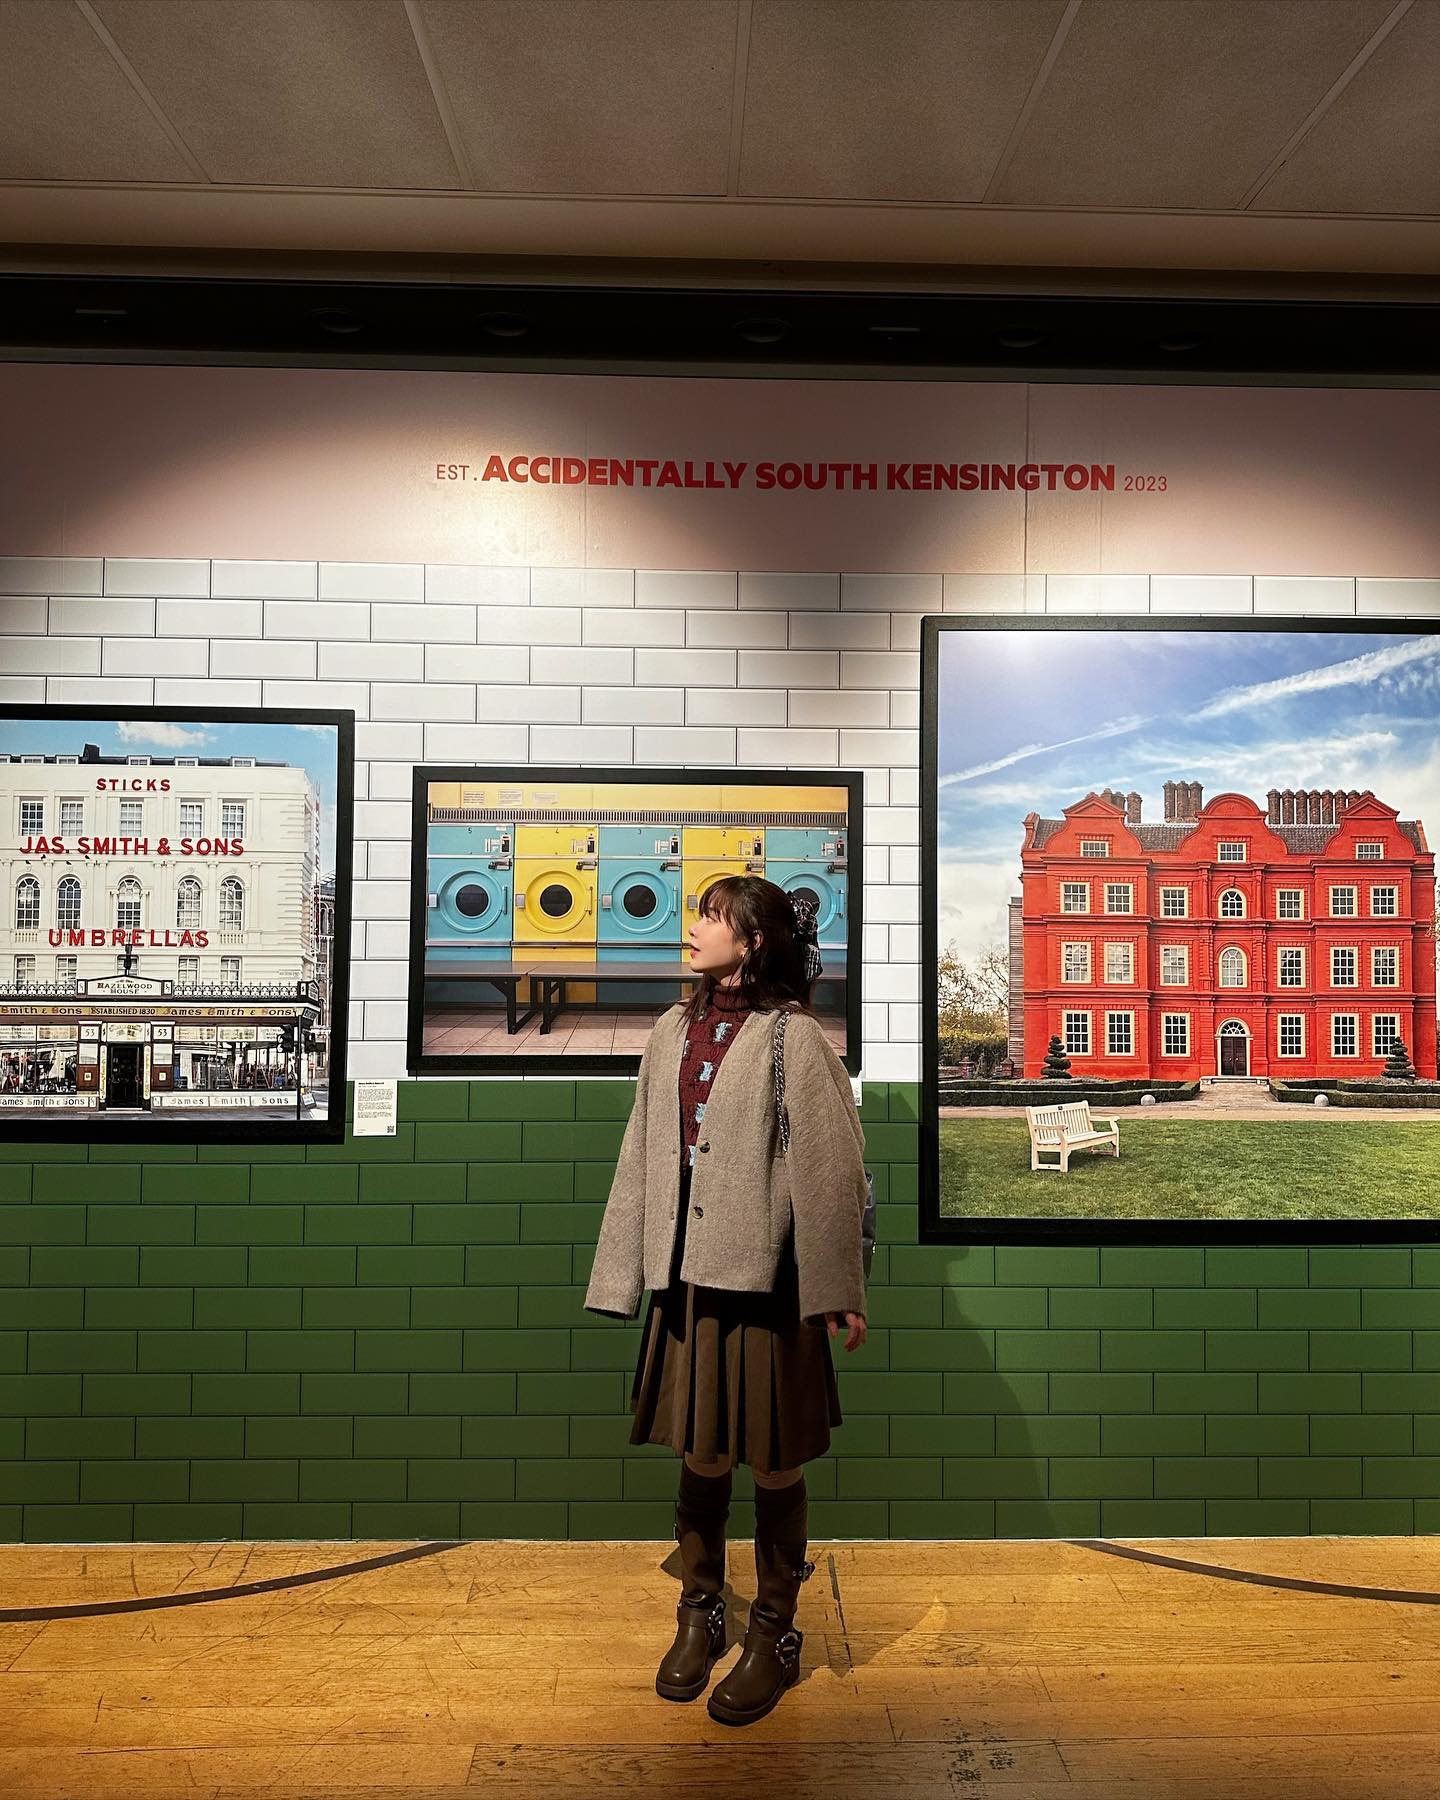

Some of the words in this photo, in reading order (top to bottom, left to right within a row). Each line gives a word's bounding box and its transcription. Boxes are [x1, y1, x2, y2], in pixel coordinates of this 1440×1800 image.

[436, 463, 478, 482] EST.
[481, 455, 748, 489] ACCIDENTALLY
[755, 462, 878, 491] SOUTH
[886, 463, 1116, 491] KENSINGTON
[1124, 474, 1168, 492] 2023
[96, 777, 171, 791] STICKS
[19, 836, 70, 854] JAS.
[77, 836, 149, 855] SMITH
[156, 837, 172, 855] &
[180, 837, 245, 856] SONS
[49, 928, 210, 948] UMBRELLAS
[85, 1028, 95, 1037] 53
[157, 1028, 168, 1037] 53
[0, 1097, 24, 1106] ames
